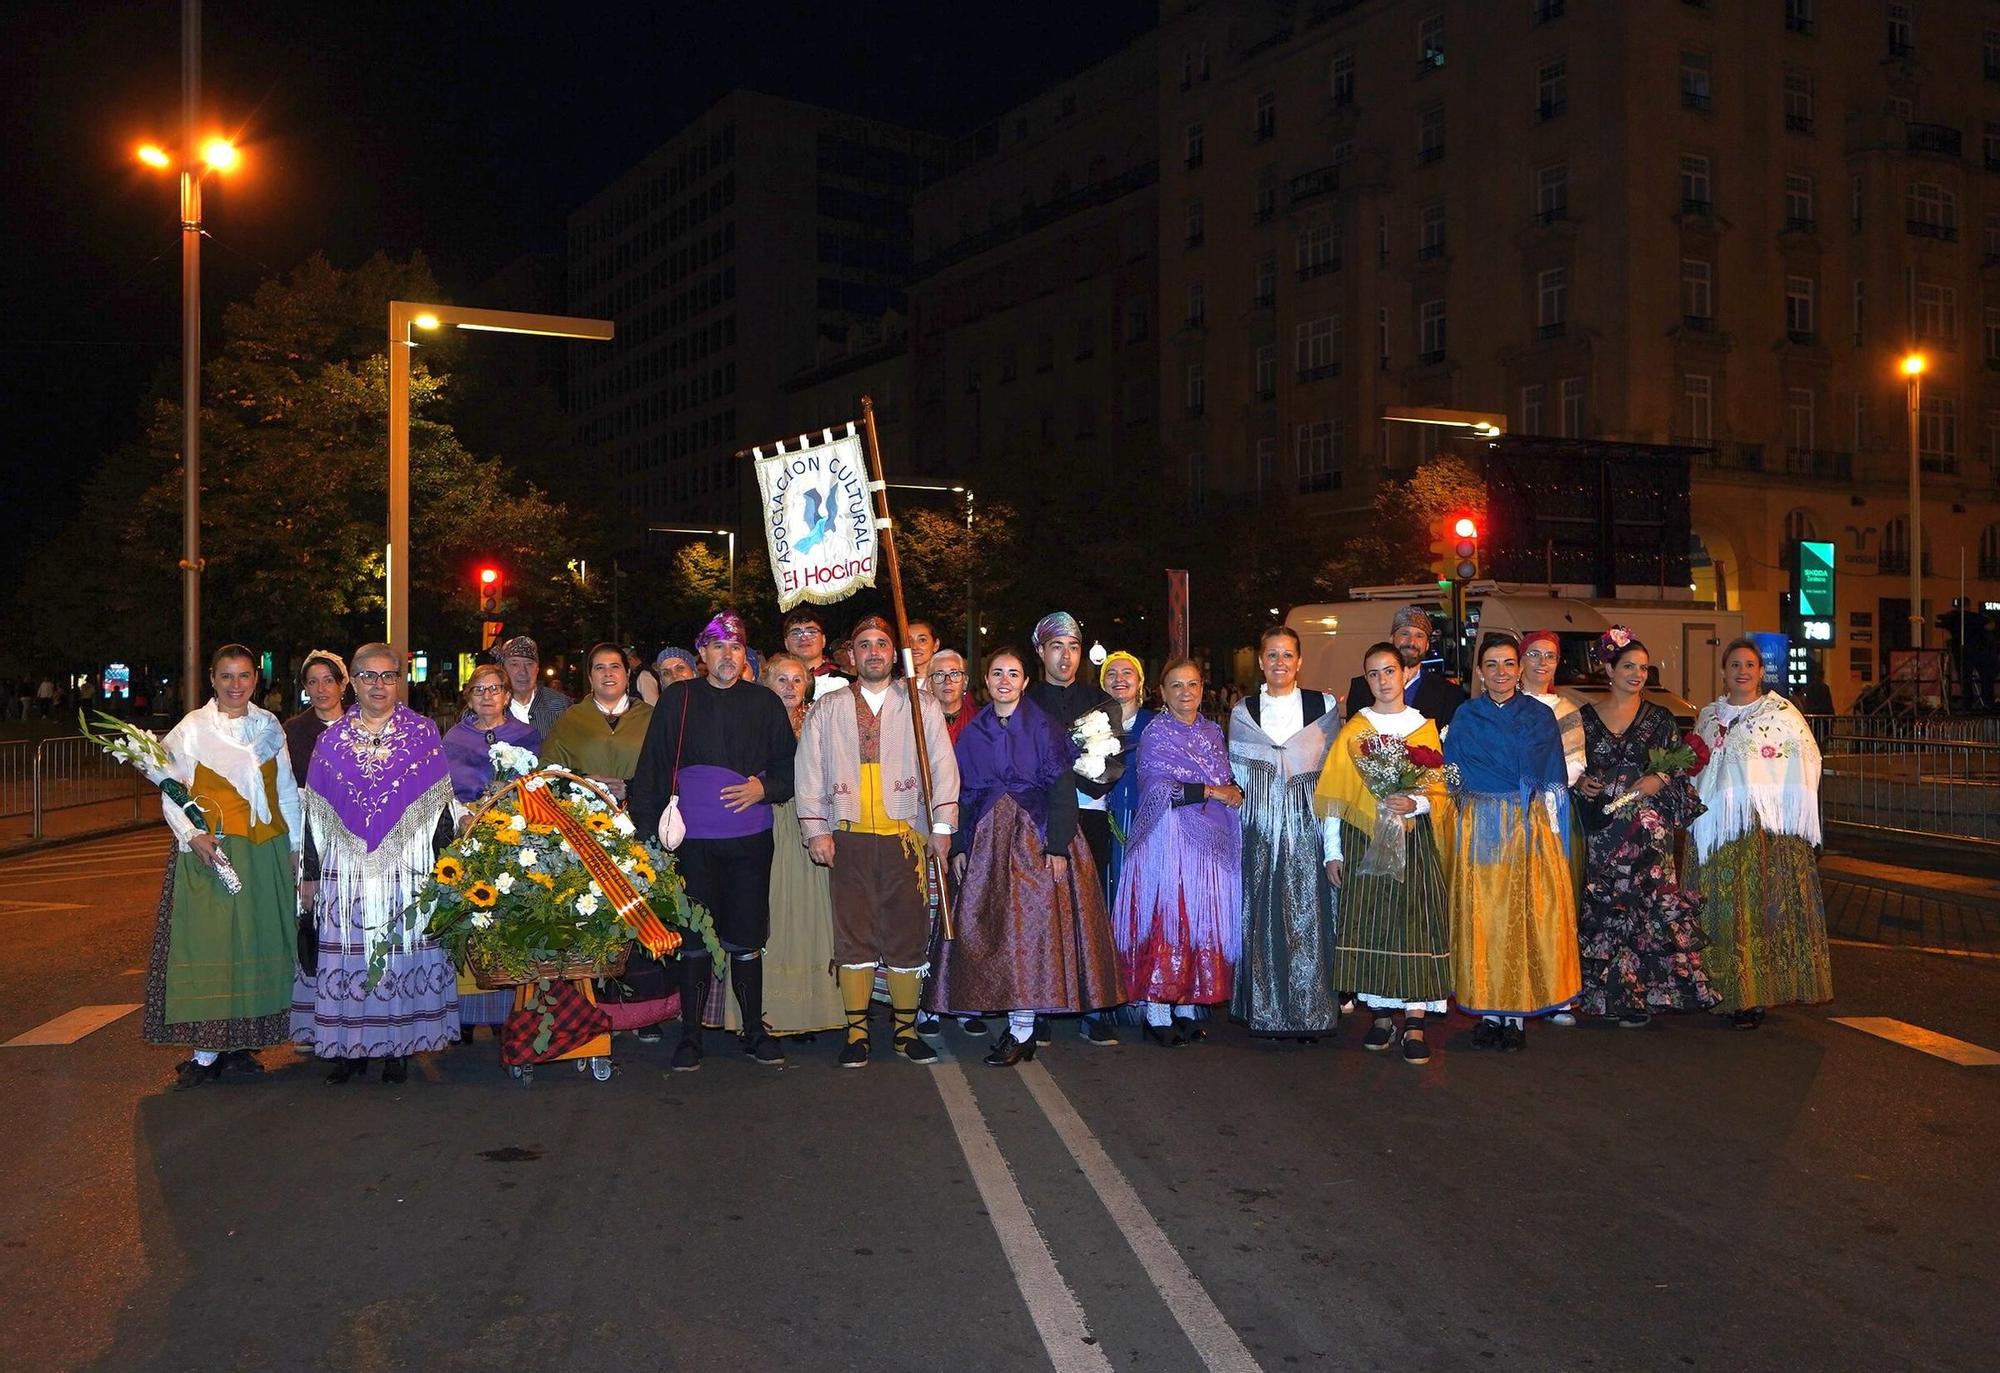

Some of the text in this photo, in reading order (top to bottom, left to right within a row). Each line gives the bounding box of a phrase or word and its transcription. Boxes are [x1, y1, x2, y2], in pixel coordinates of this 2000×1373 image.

[772, 457, 870, 563] ASOCIACIÓN CULTURAL
[783, 570, 798, 592] El
[1803, 622, 1831, 640] 7:
